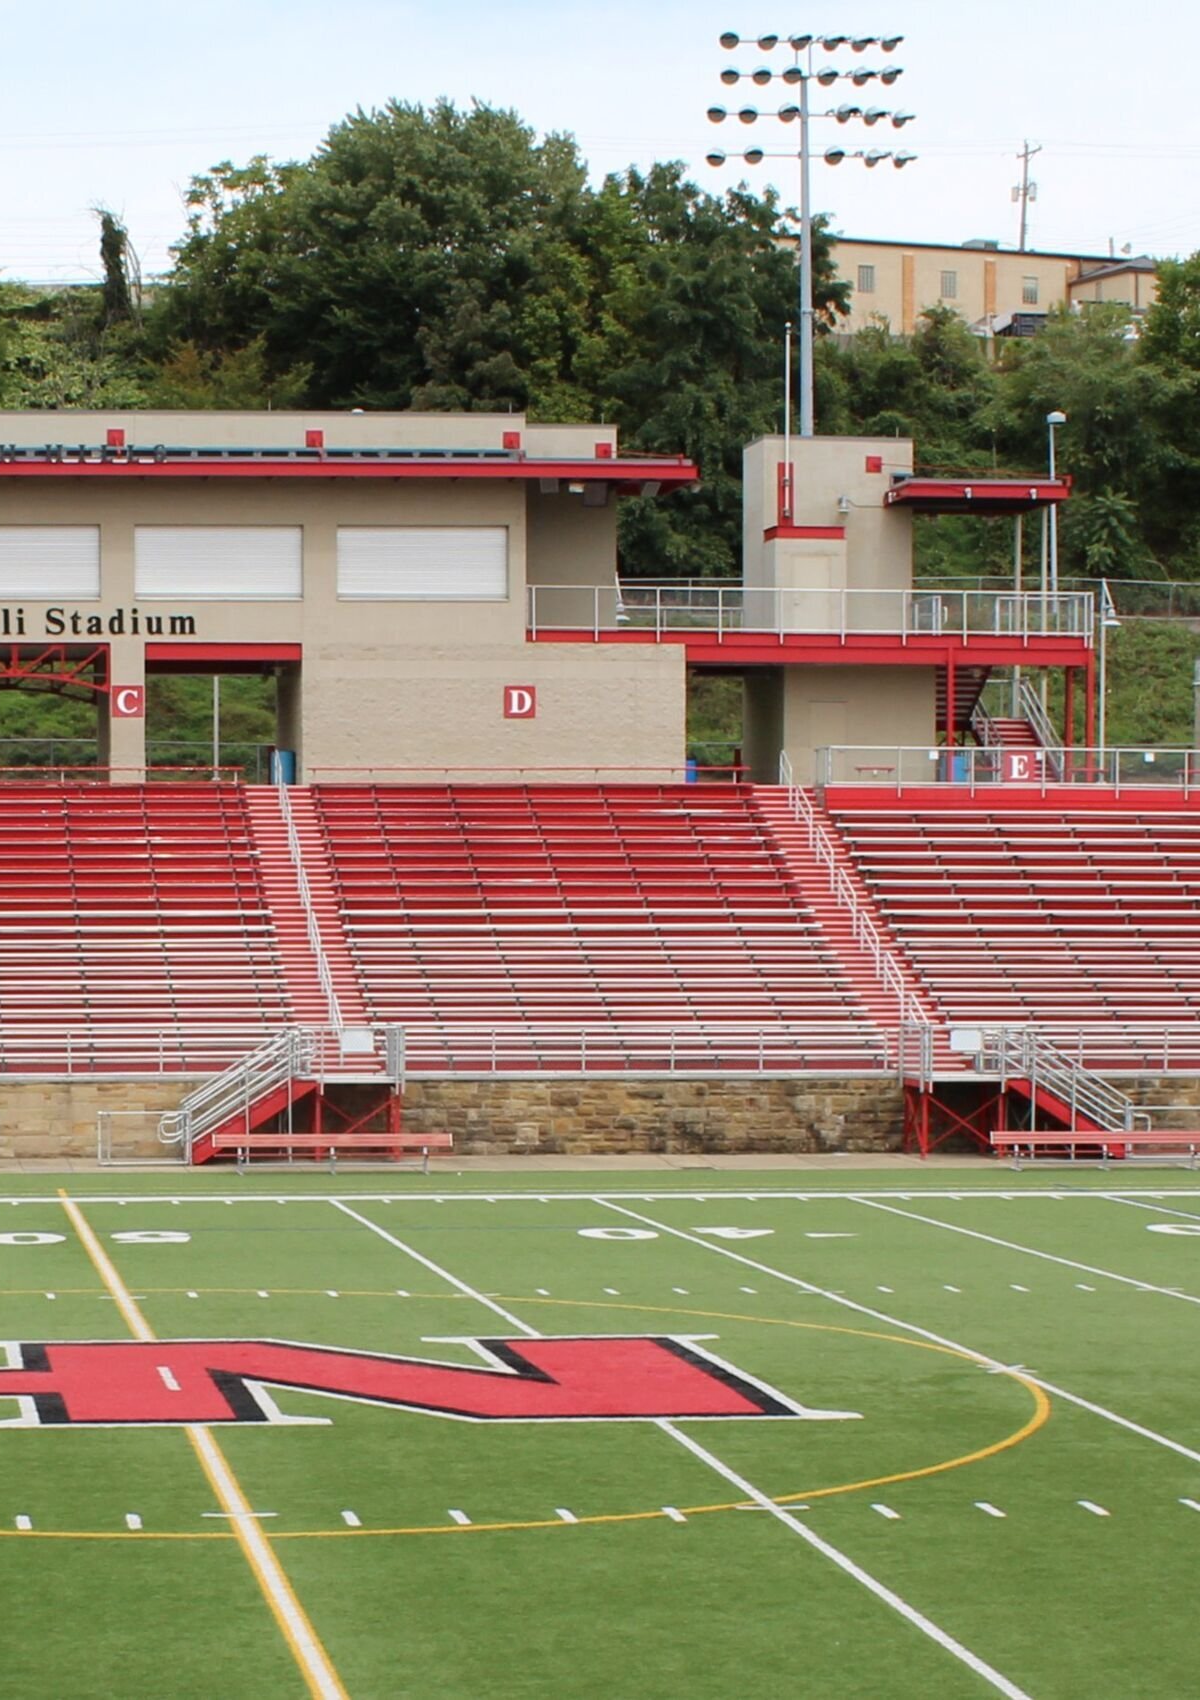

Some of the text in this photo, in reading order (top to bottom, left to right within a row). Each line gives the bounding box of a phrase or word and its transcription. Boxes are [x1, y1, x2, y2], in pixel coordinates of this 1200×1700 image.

[45, 608, 197, 636] Stadium
[116, 689, 139, 714] C
[508, 689, 532, 714] D
[1009, 754, 1030, 780] E
